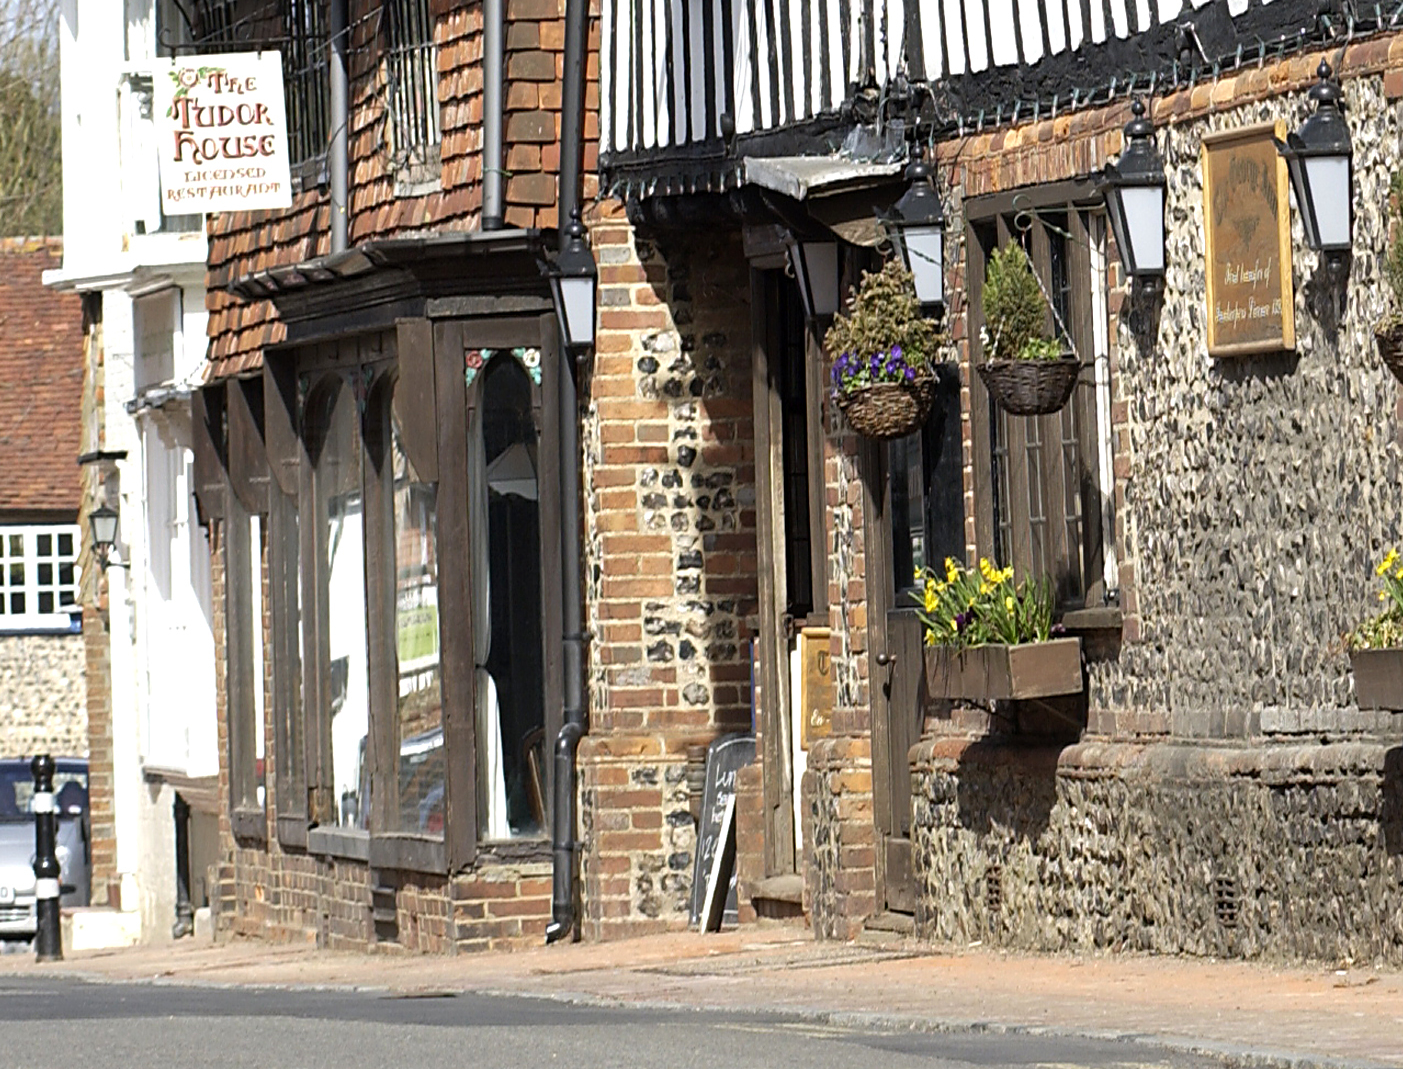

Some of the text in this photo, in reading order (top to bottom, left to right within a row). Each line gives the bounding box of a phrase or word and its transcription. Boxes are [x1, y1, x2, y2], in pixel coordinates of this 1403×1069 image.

[171, 97, 275, 129] TUDOR
[184, 167, 266, 183] LICENSED
[167, 182, 281, 202] RESTAURANT
